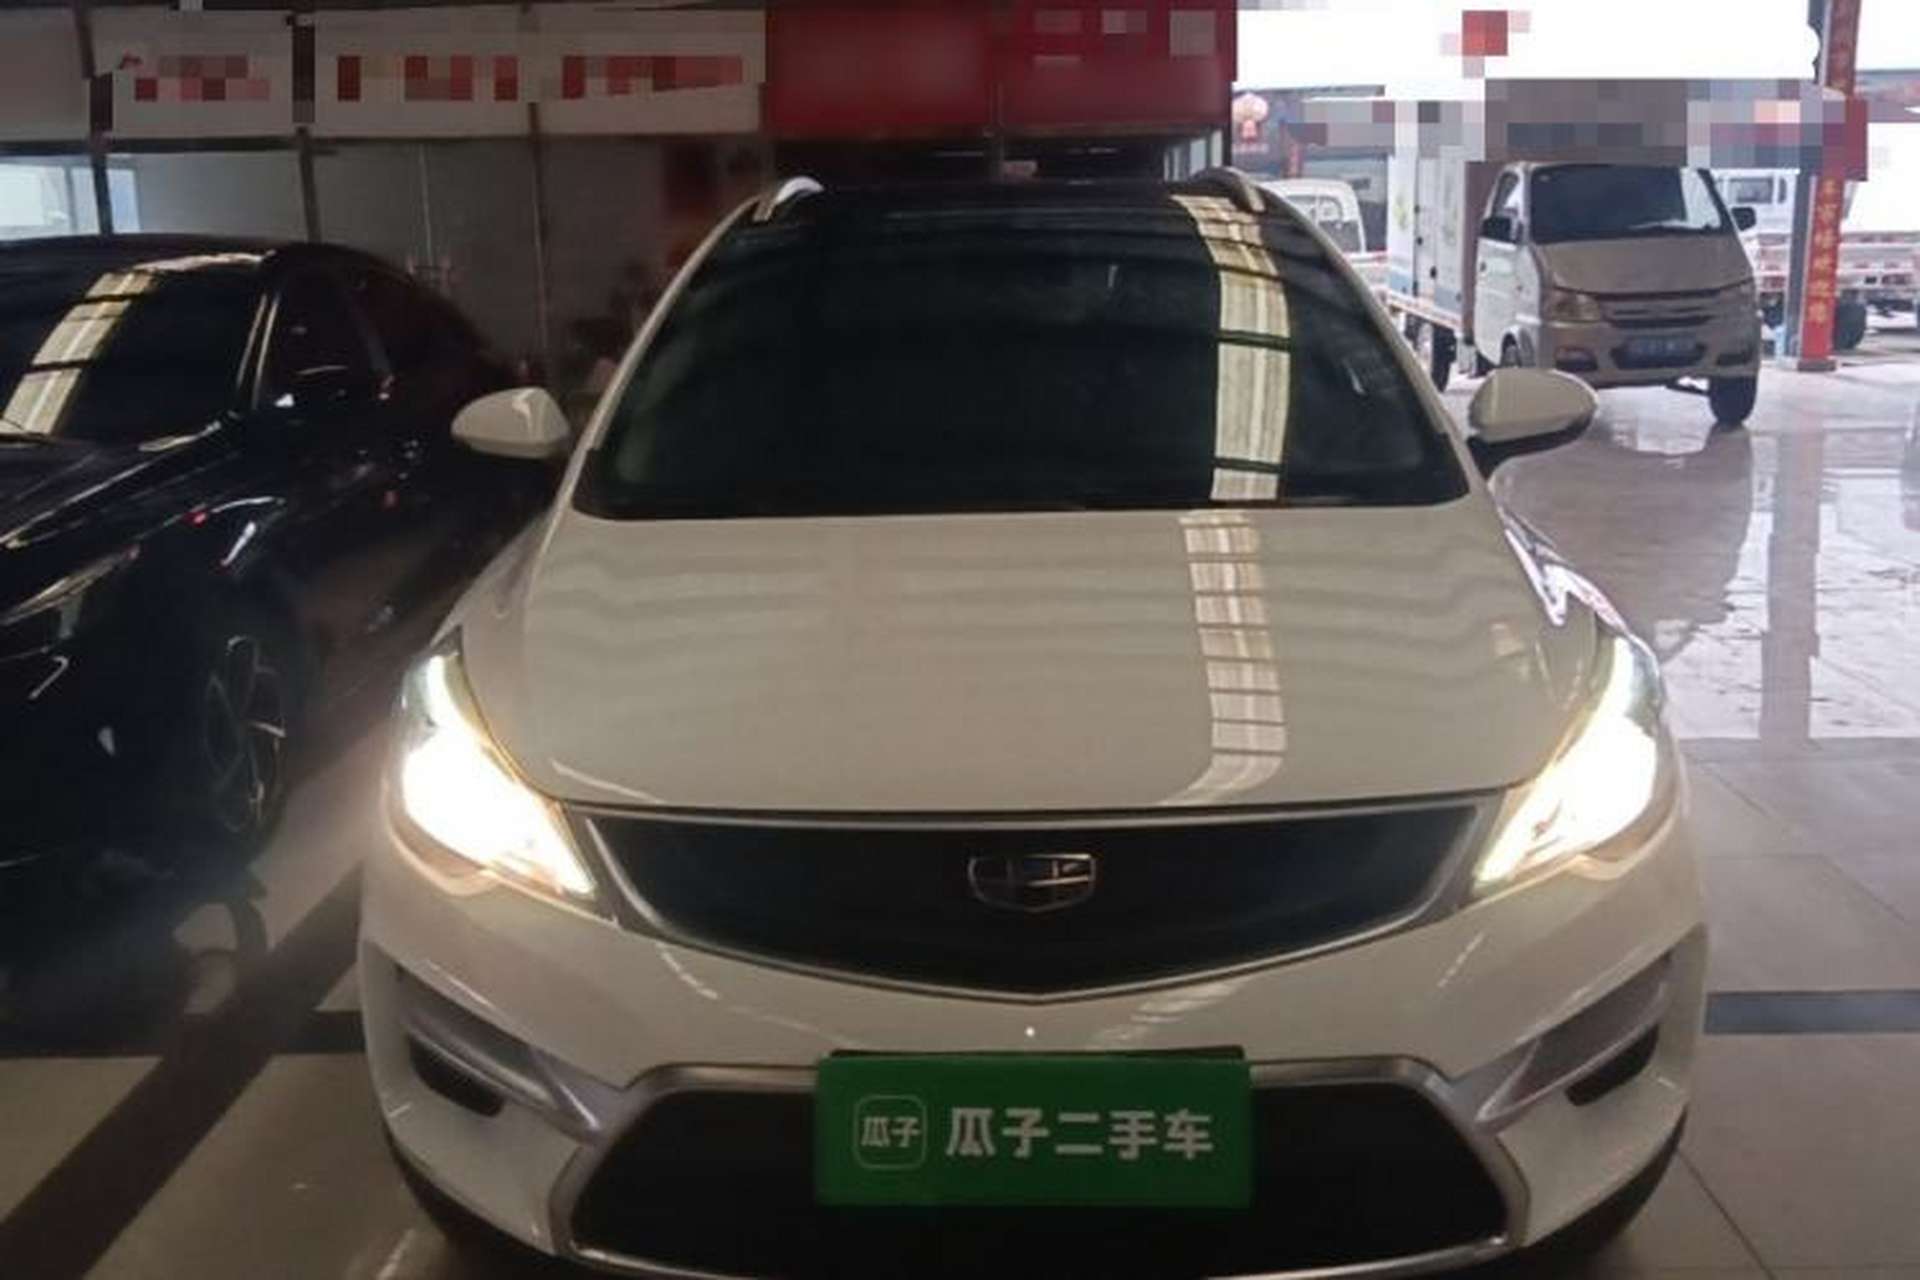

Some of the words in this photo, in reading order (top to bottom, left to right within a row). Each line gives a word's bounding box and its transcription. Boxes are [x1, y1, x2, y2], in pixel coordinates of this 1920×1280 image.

[861, 1116, 921, 1148] 瓜子
[945, 1107, 1214, 1159] 瓜子二手车
